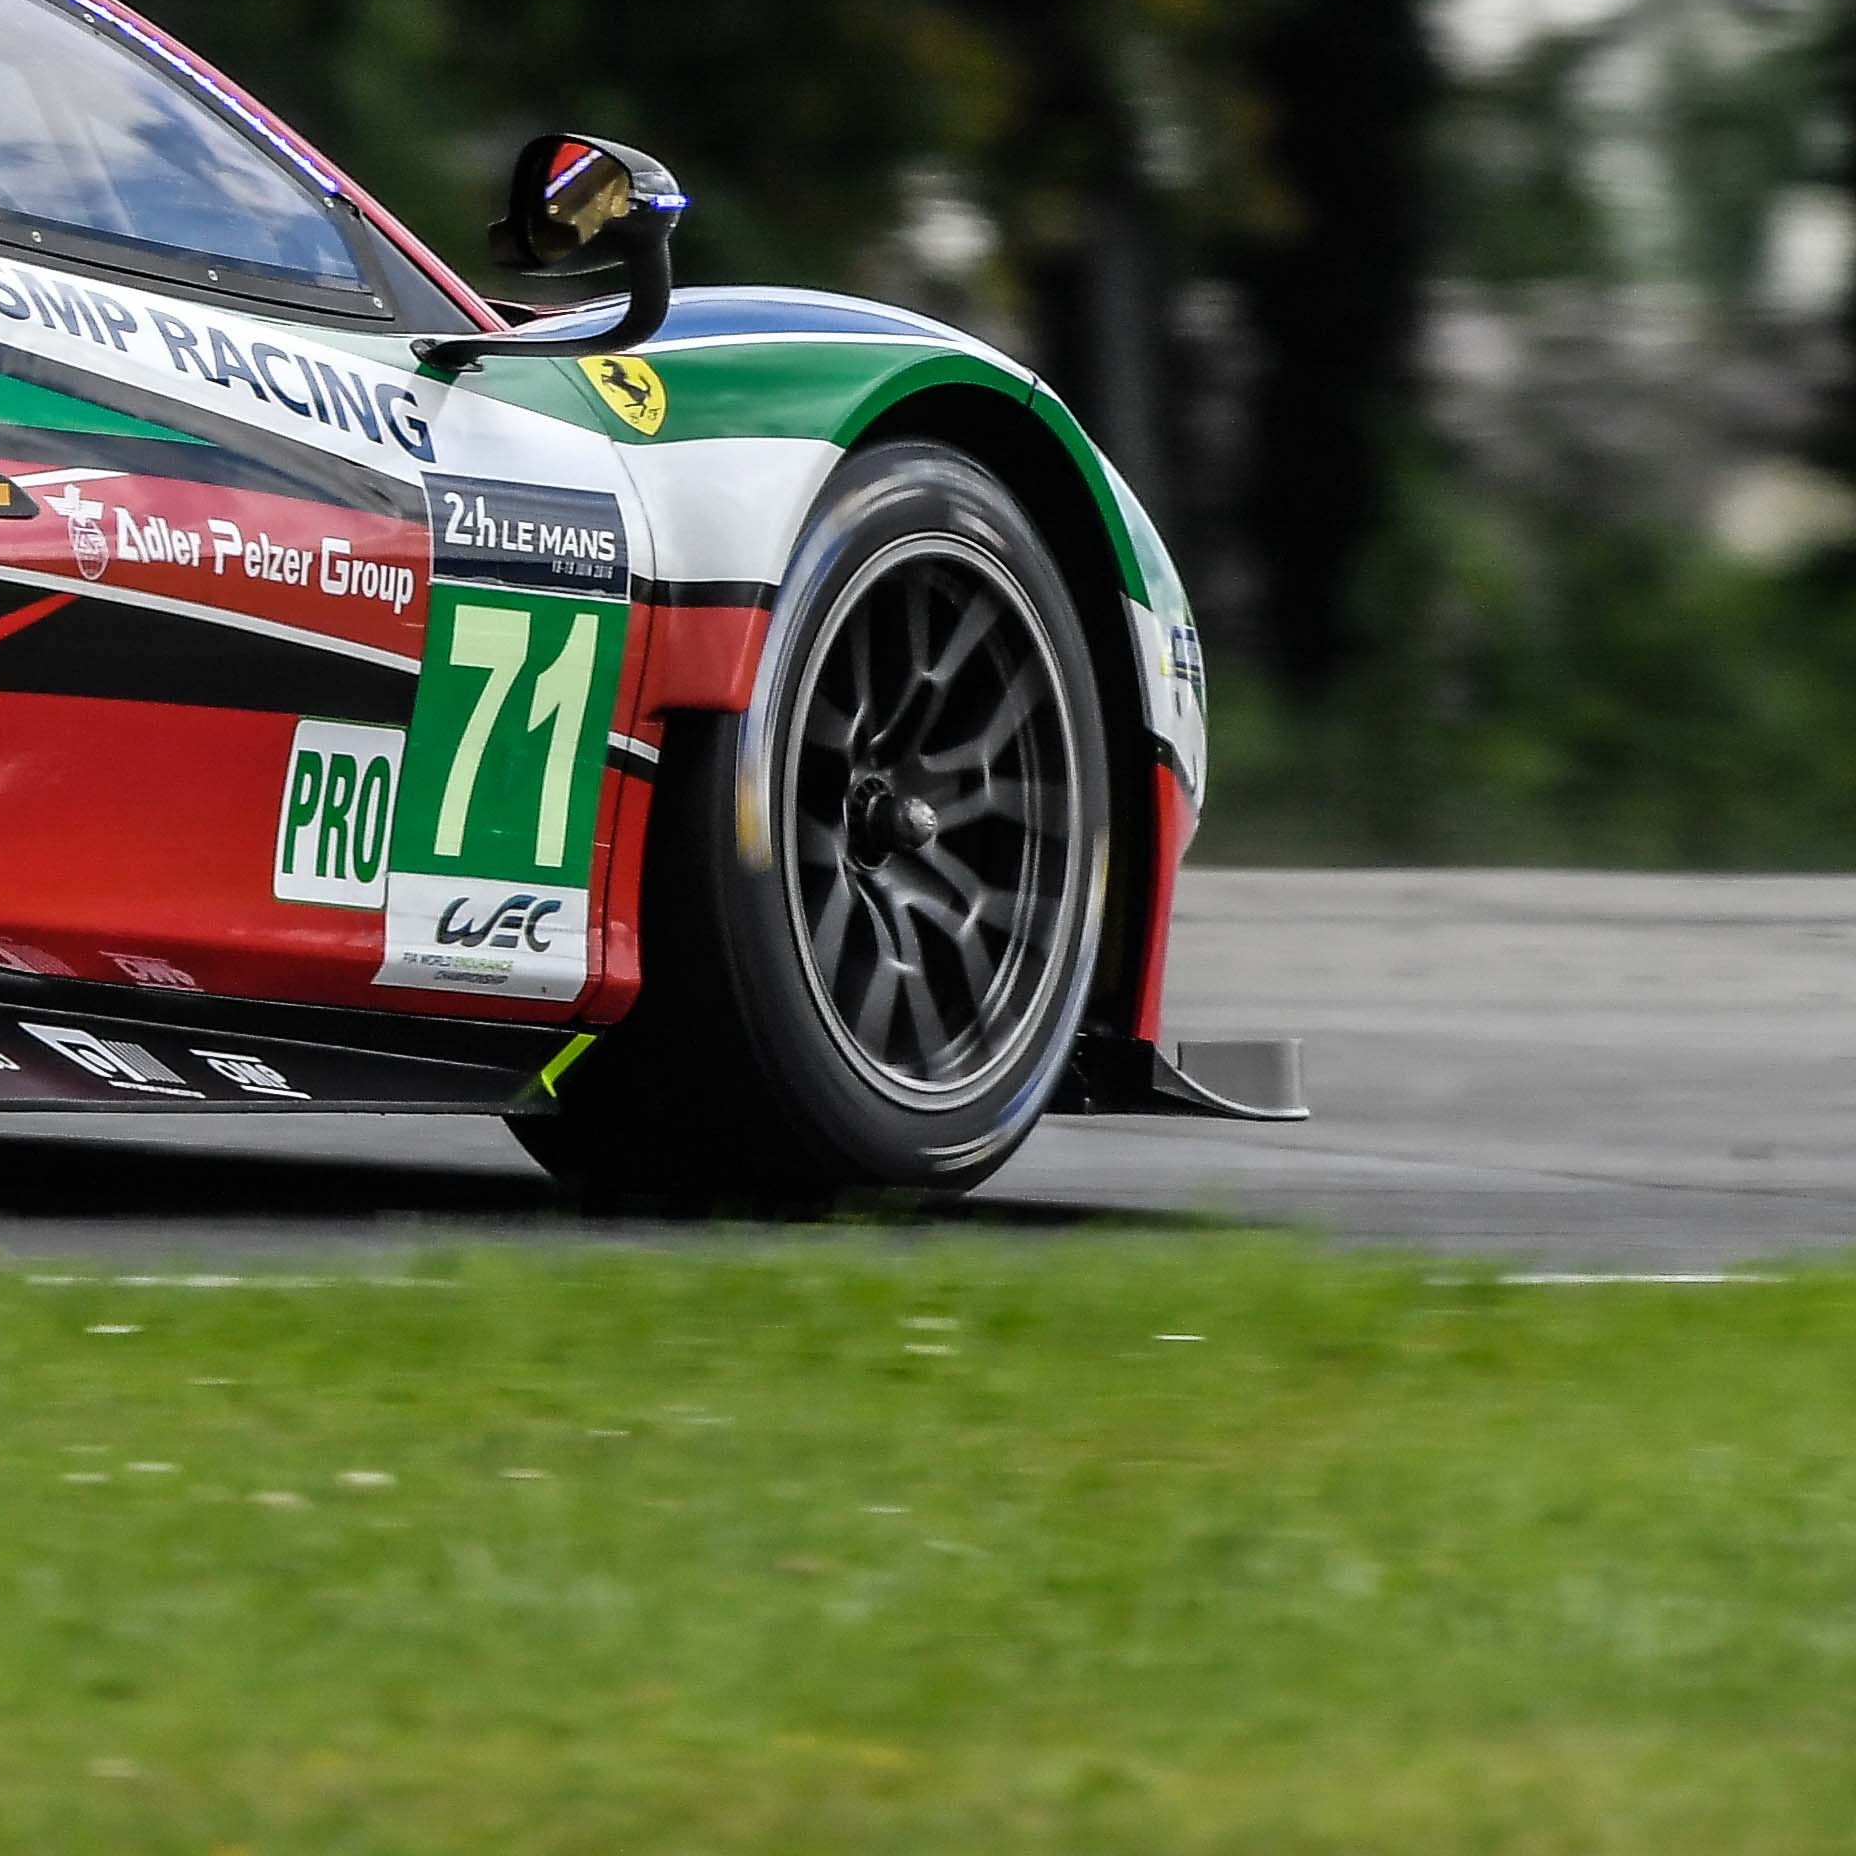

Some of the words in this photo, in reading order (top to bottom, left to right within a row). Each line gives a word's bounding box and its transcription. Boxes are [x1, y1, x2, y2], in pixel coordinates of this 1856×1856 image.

[145, 308, 437, 463] RACING
[114, 507, 201, 567] Adler
[208, 518, 313, 586] Pelzer
[320, 537, 413, 615] Group
[501, 520, 536, 552] LE
[538, 523, 616, 562] MANS
[432, 603, 598, 868] 71
[282, 749, 392, 884] PRO
[435, 893, 563, 953] WEC
